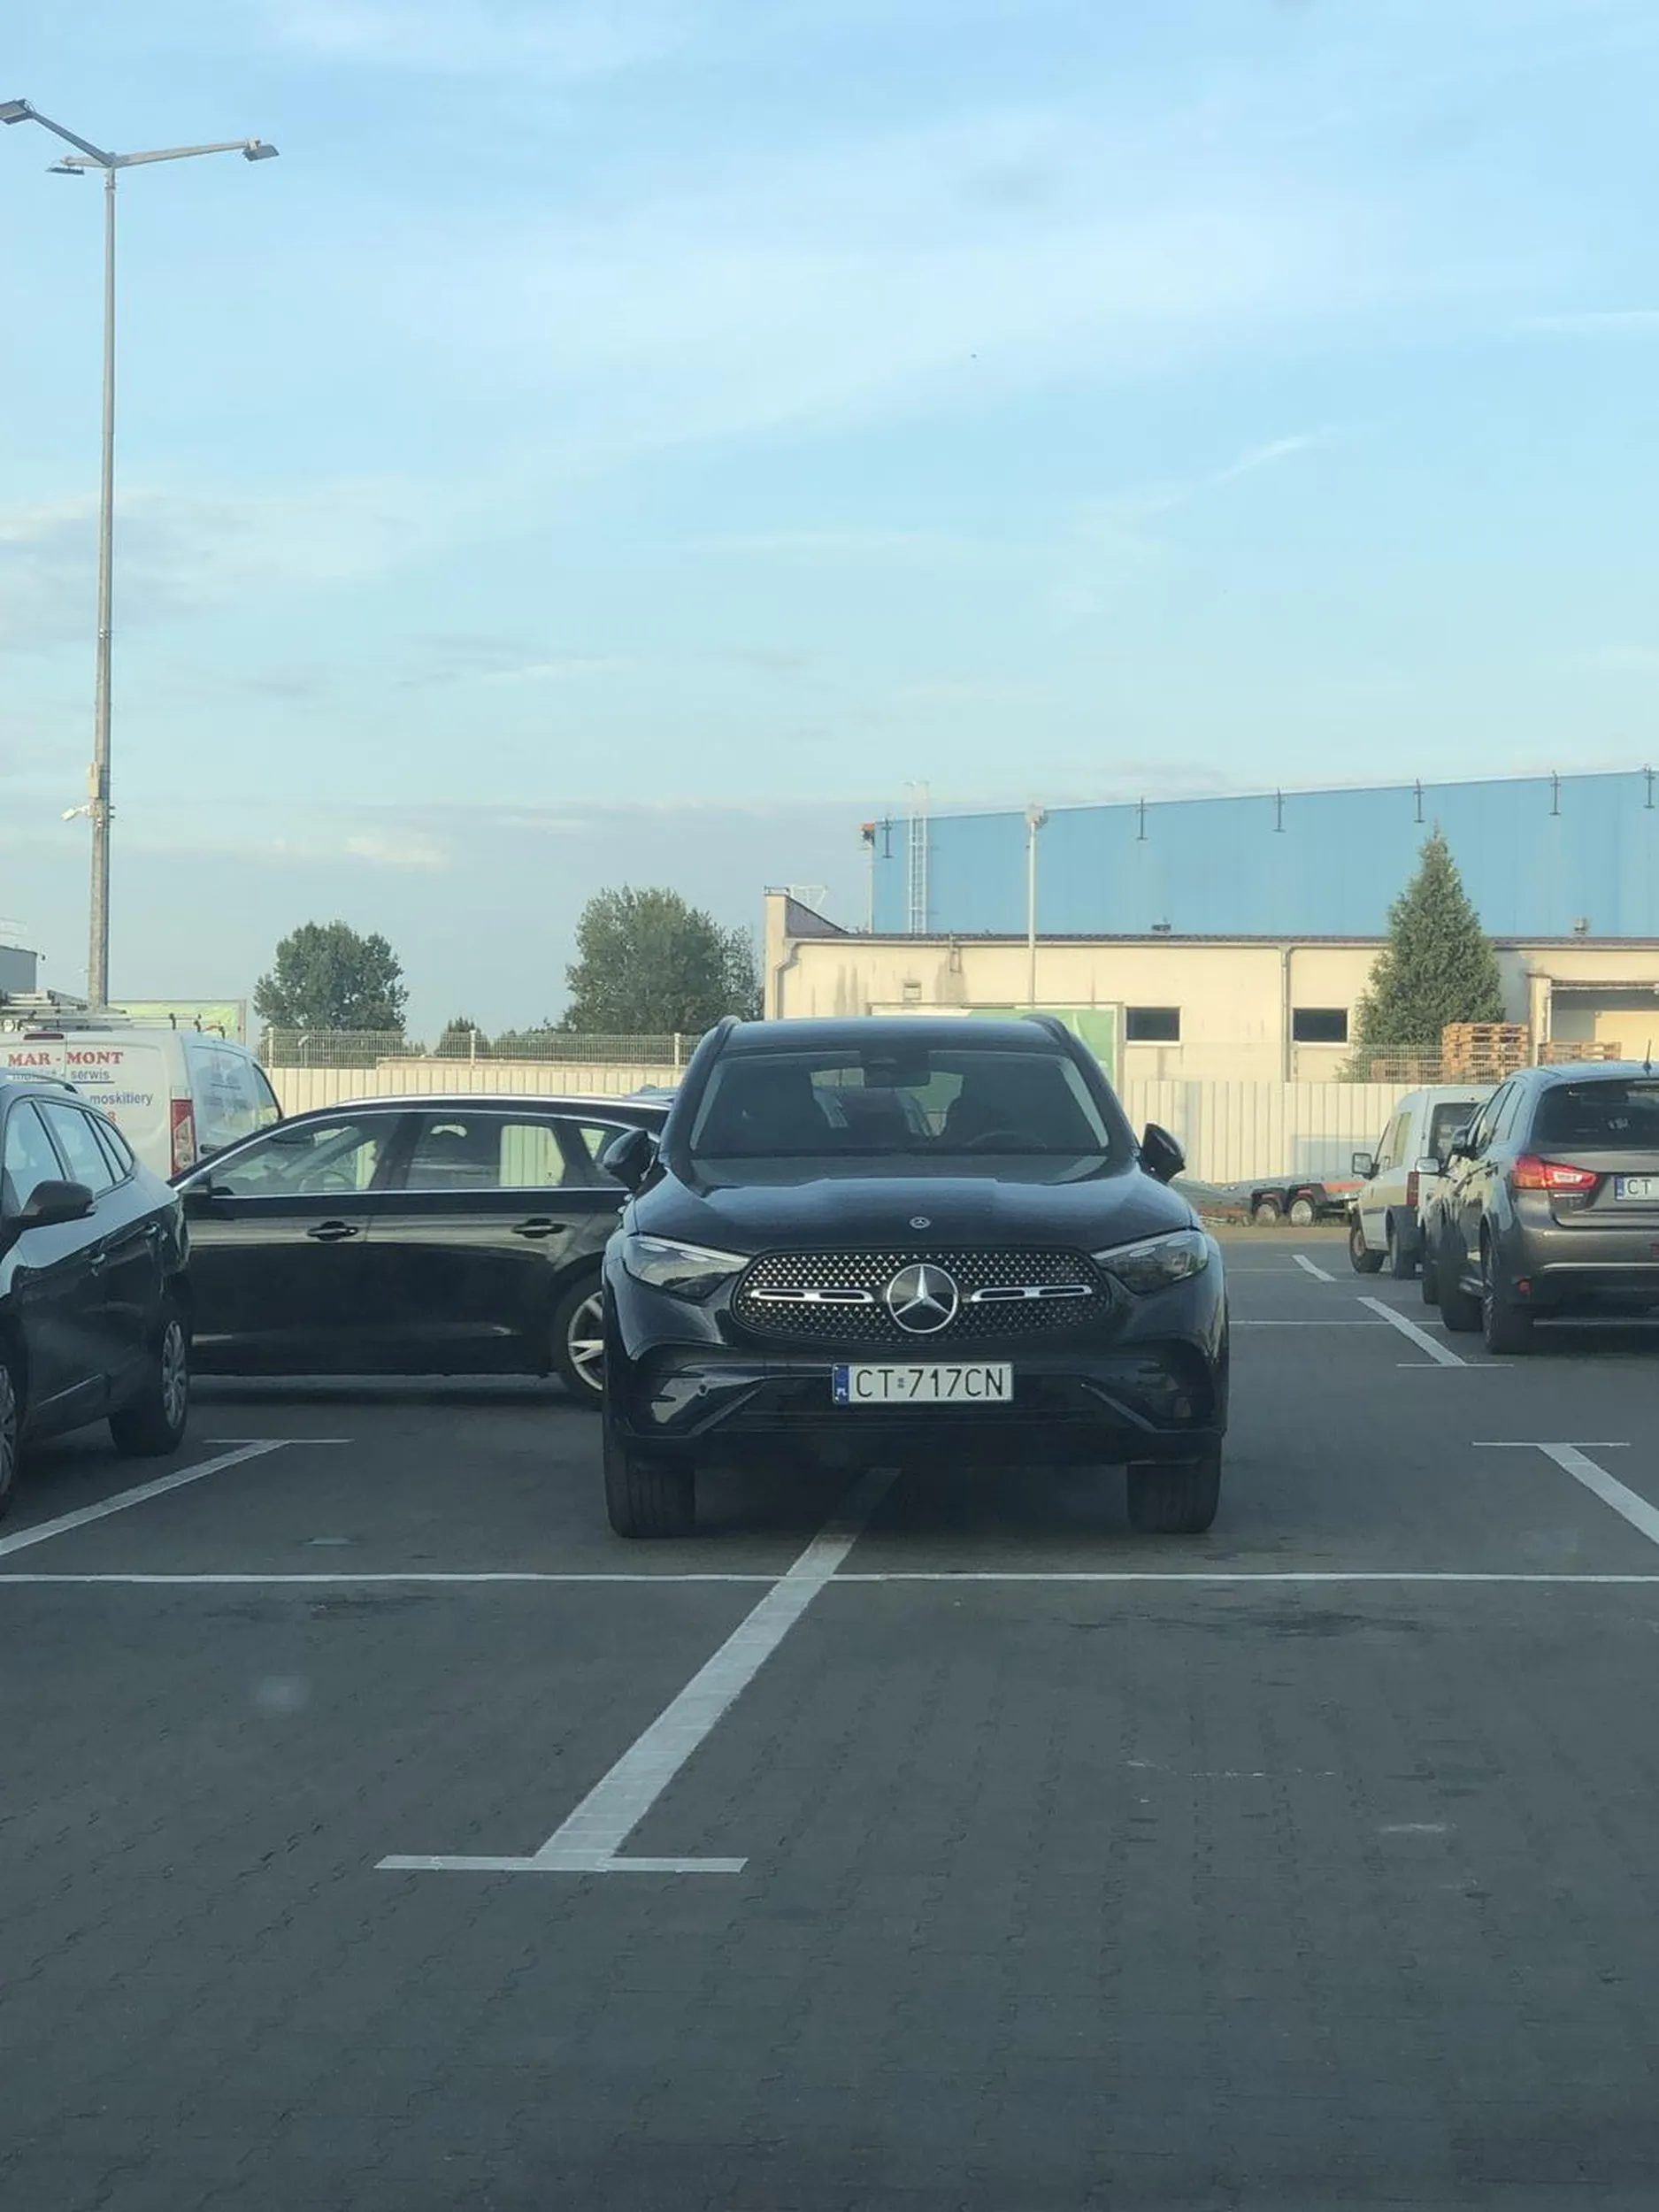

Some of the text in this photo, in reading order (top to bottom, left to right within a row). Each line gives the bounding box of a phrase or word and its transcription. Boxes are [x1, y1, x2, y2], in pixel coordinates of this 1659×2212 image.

[8, 1052, 50, 1067] MAR
[66, 1051, 123, 1065] MONT
[71, 1068, 111, 1080] serwis
[89, 1091, 154, 1106] moskitiery
[1627, 1179, 1652, 1195] CT
[856, 1368, 1003, 1398] CT 717CN
